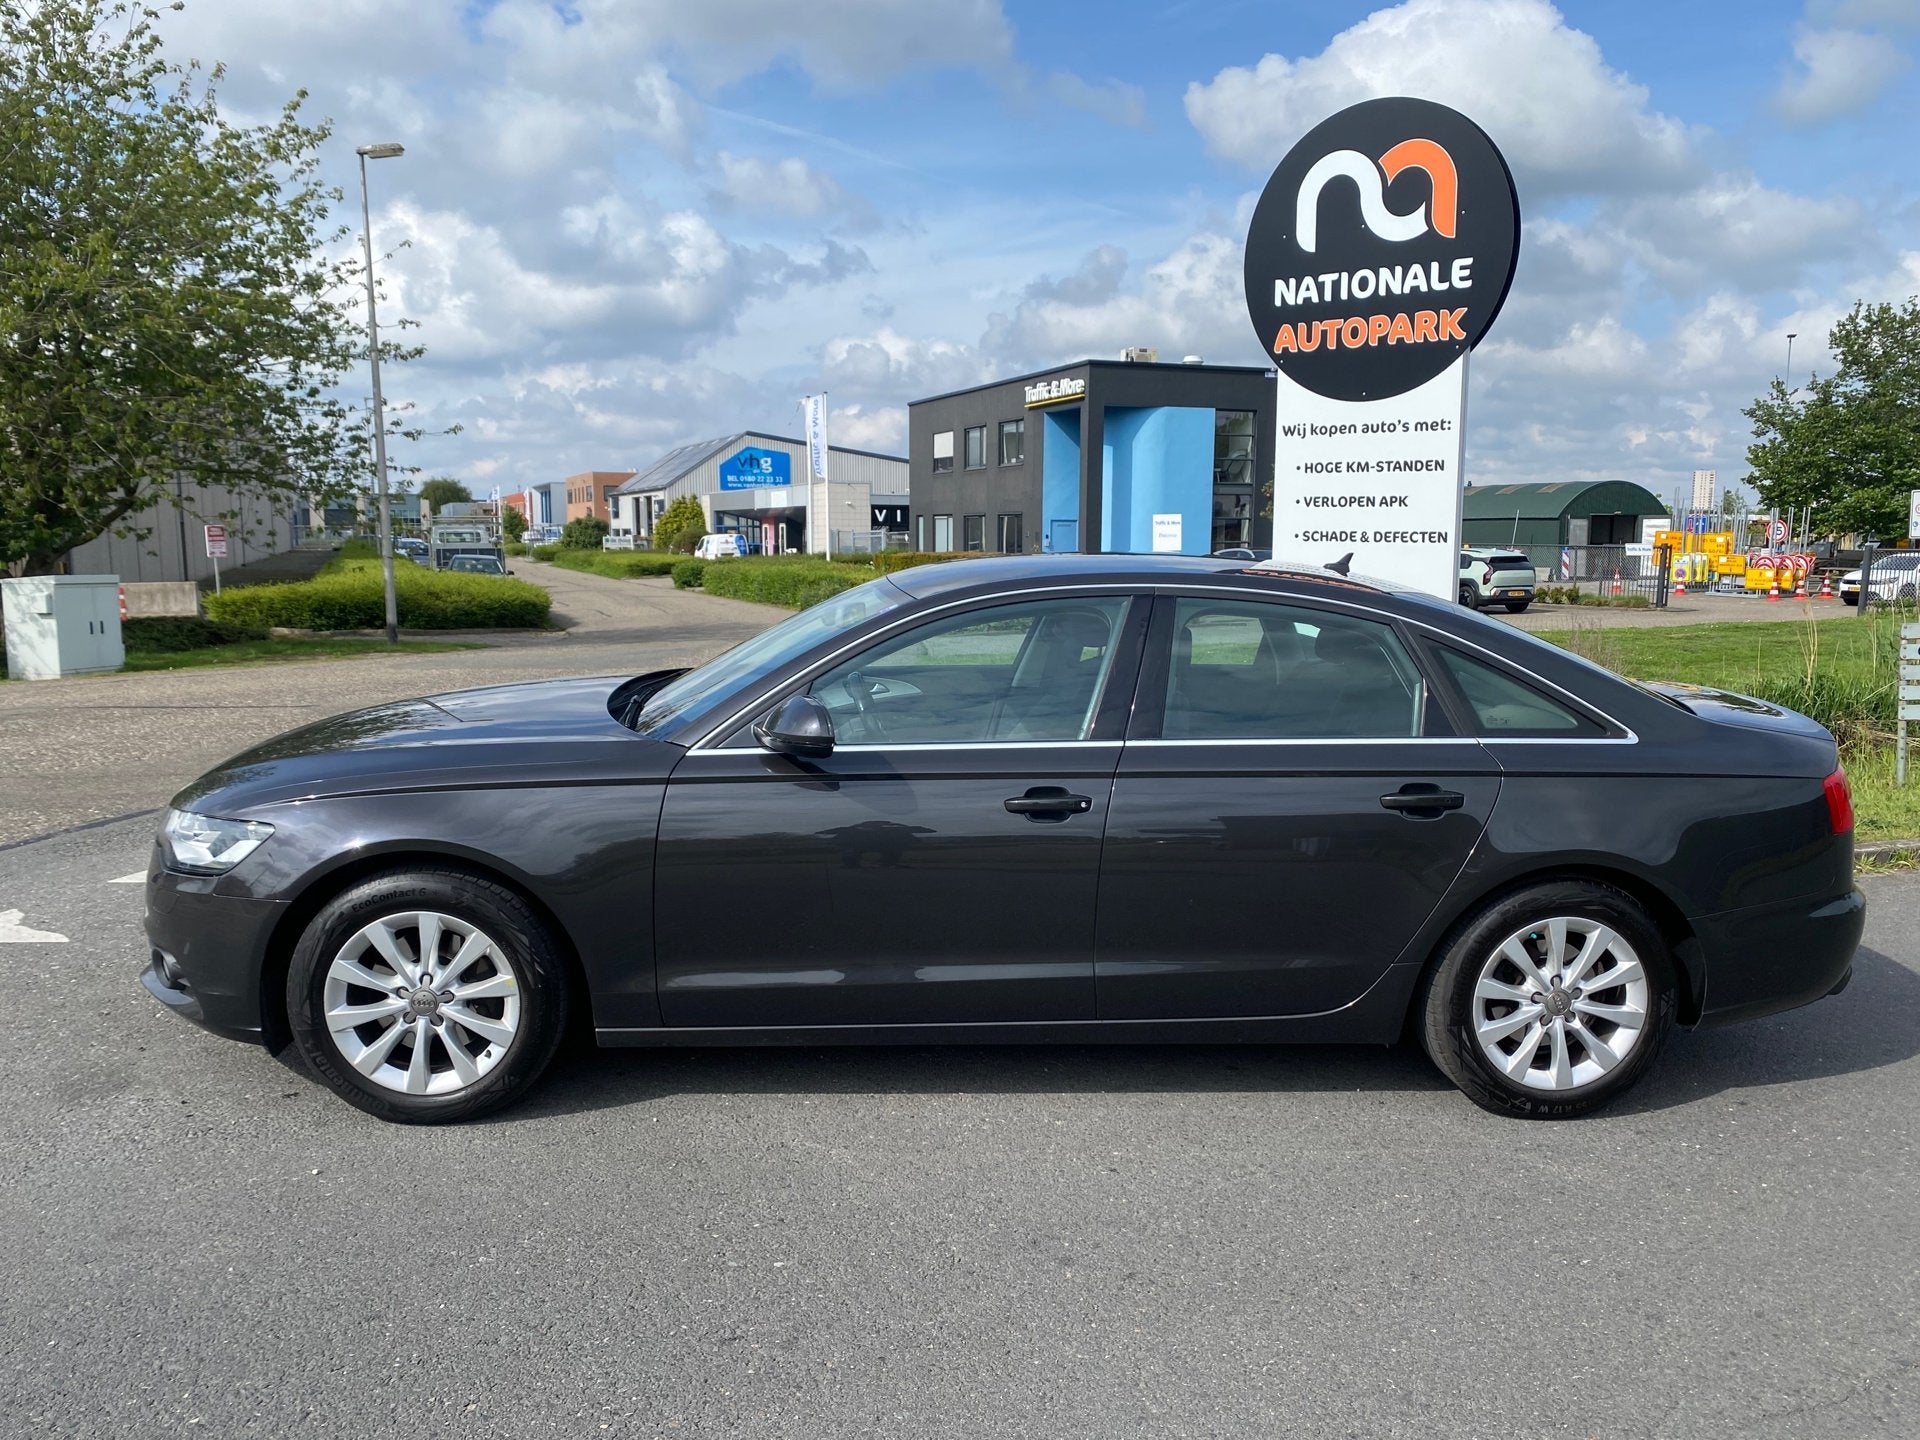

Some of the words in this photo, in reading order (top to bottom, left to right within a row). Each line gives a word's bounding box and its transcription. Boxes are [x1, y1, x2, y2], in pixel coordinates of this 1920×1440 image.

[1274, 257, 1474, 307] NATIONALE
[1273, 307, 1468, 354] AUTOPARK
[1282, 423, 1307, 439] Wij
[1310, 423, 1357, 438] kopen
[1361, 419, 1410, 434] auto's
[1414, 418, 1452, 432] met:
[737, 453, 773, 473] vhg
[1304, 461, 1343, 474] HOGE
[1346, 459, 1445, 473] KM-STANDEN
[1304, 496, 1376, 507] VERLOPEN
[1379, 495, 1409, 507] APK
[1302, 530, 1357, 542] SCHADE
[1360, 531, 1370, 543] &
[1373, 530, 1448, 543] DEFECTEN
[351, 888, 416, 912] EcoContact
